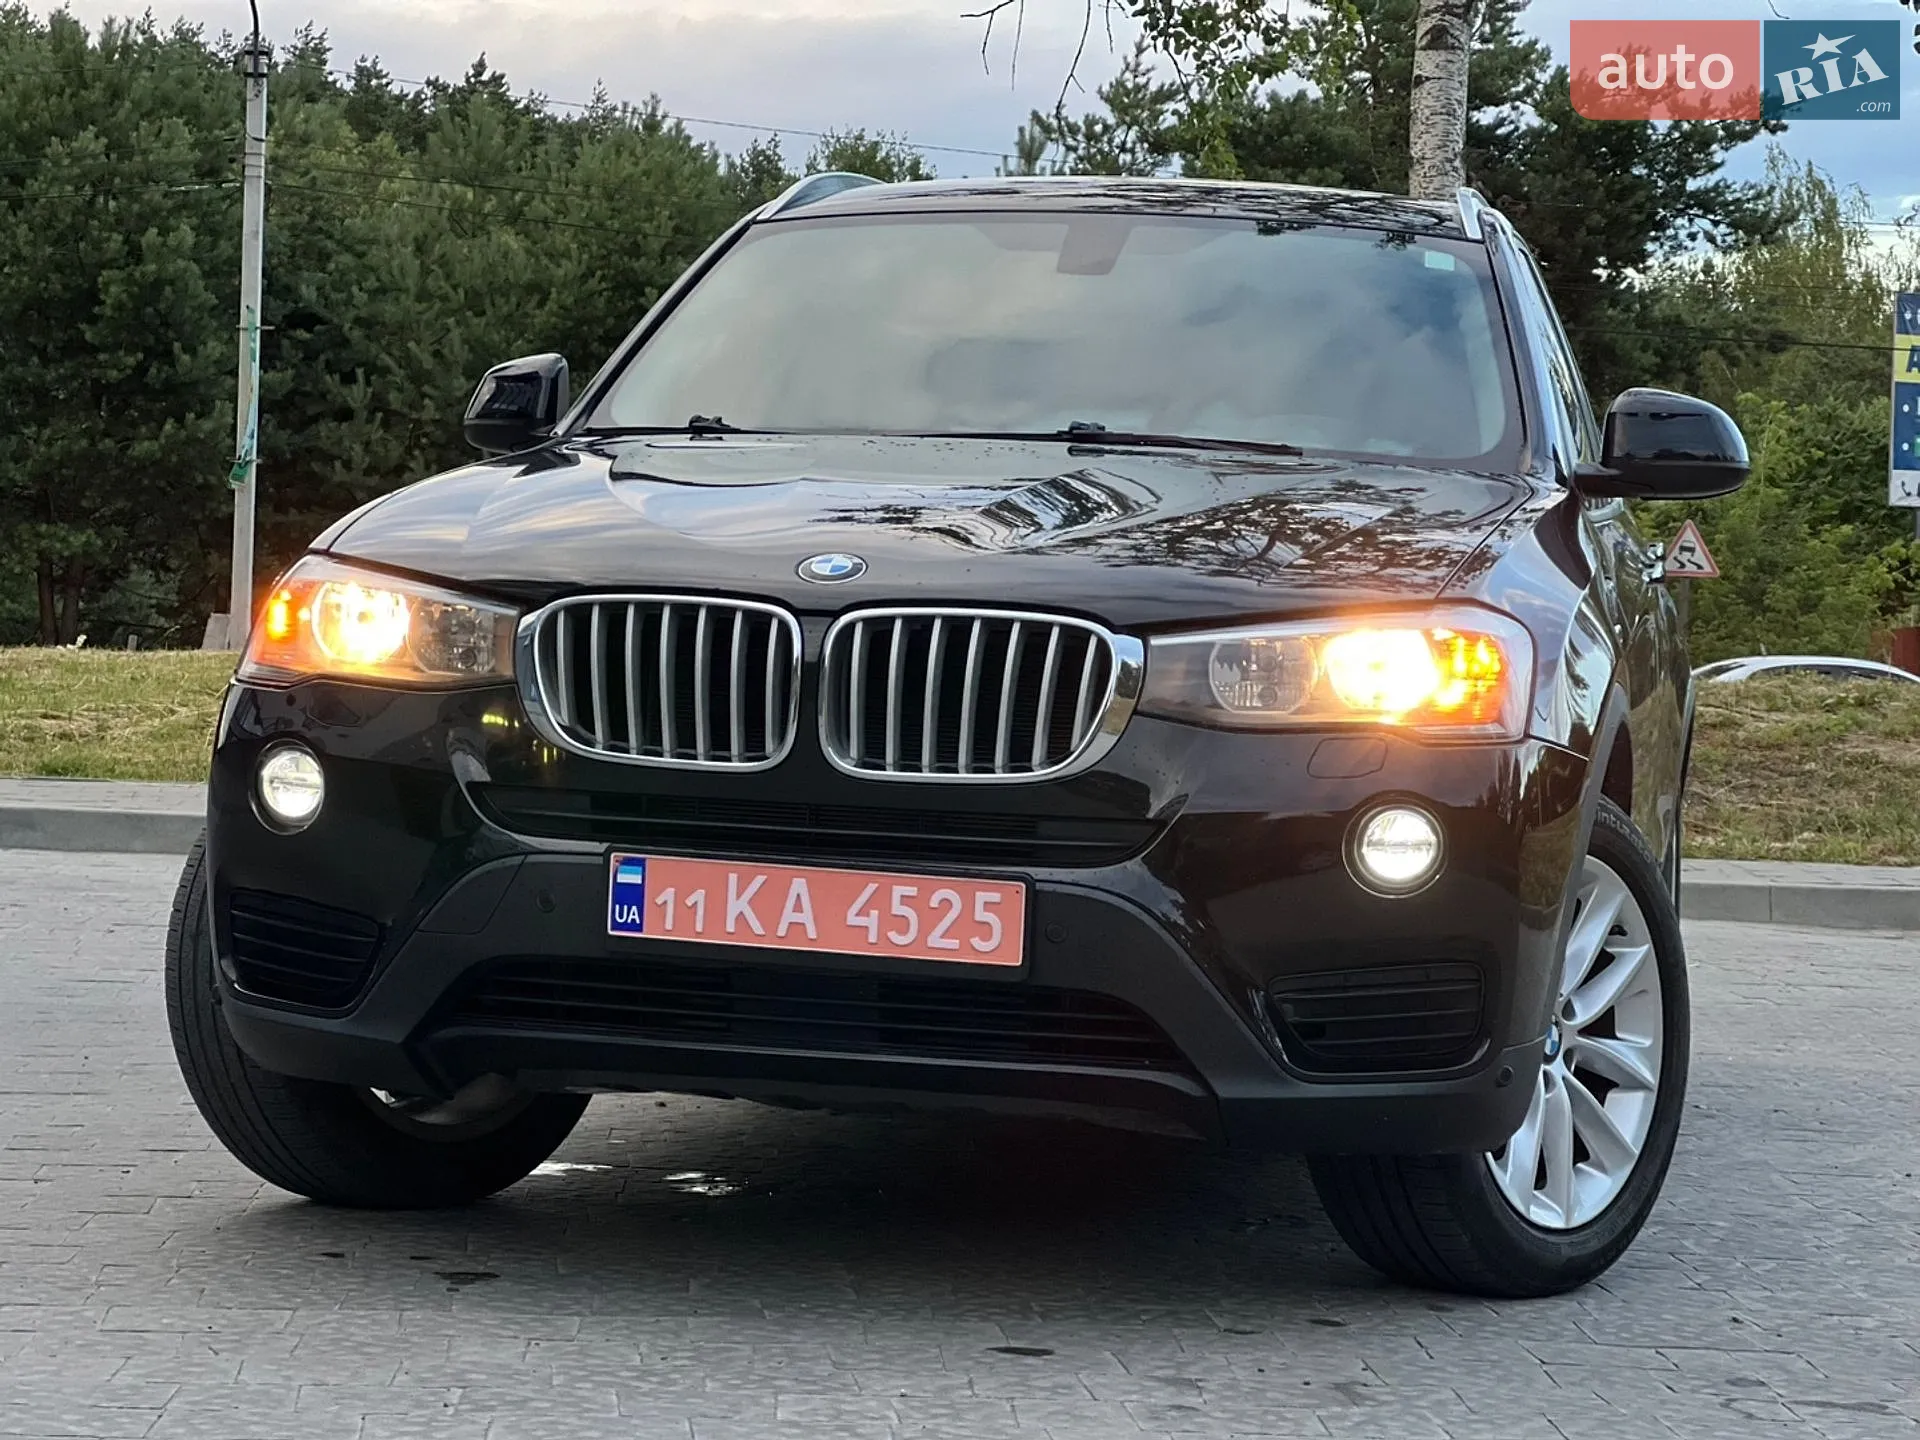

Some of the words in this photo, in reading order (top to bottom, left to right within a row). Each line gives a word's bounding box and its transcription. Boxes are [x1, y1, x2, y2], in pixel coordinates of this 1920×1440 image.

[614, 904, 640, 925] UA
[654, 887, 706, 933] 11
[725, 873, 818, 940] KA
[846, 883, 1003, 953] 4525
